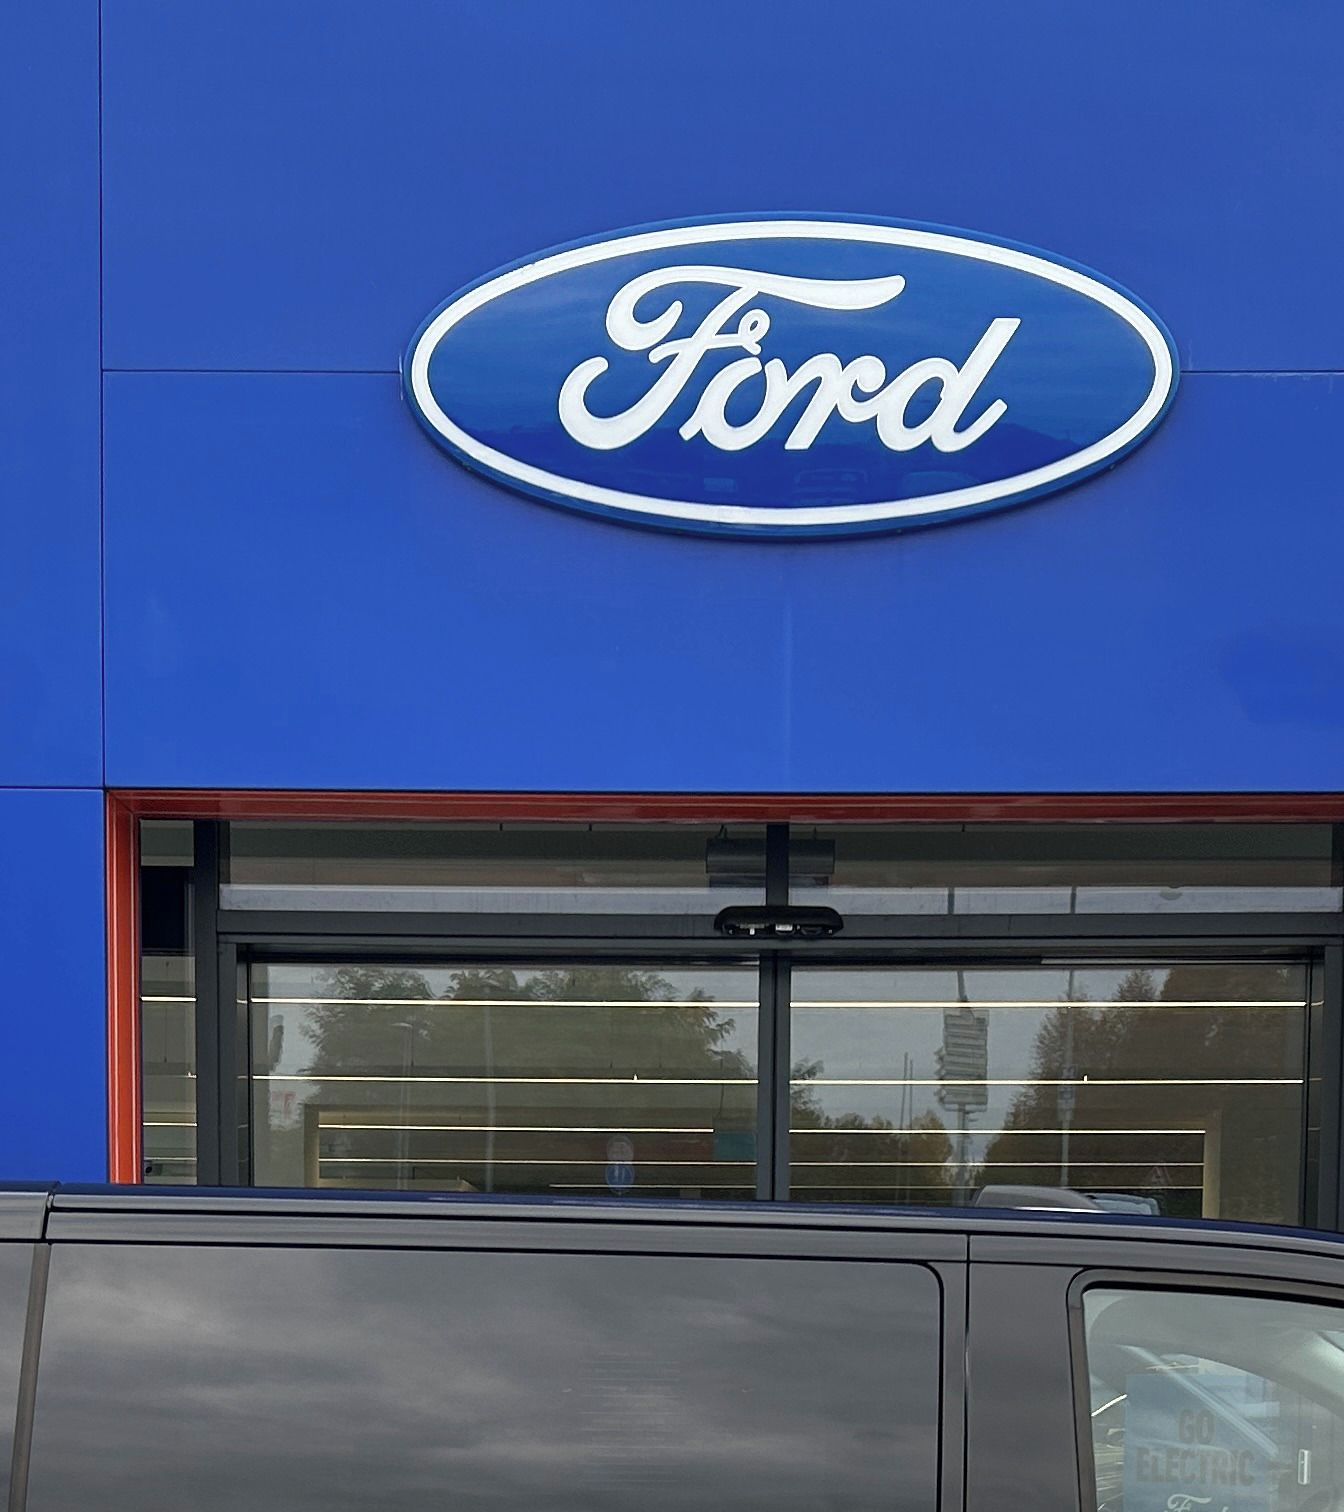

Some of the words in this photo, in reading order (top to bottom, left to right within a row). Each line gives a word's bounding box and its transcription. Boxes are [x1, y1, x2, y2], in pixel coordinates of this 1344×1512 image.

[558, 265, 1021, 452] Ford
[1178, 1409, 1216, 1443] GO
[1135, 1448, 1256, 1486] ELECTRIC
